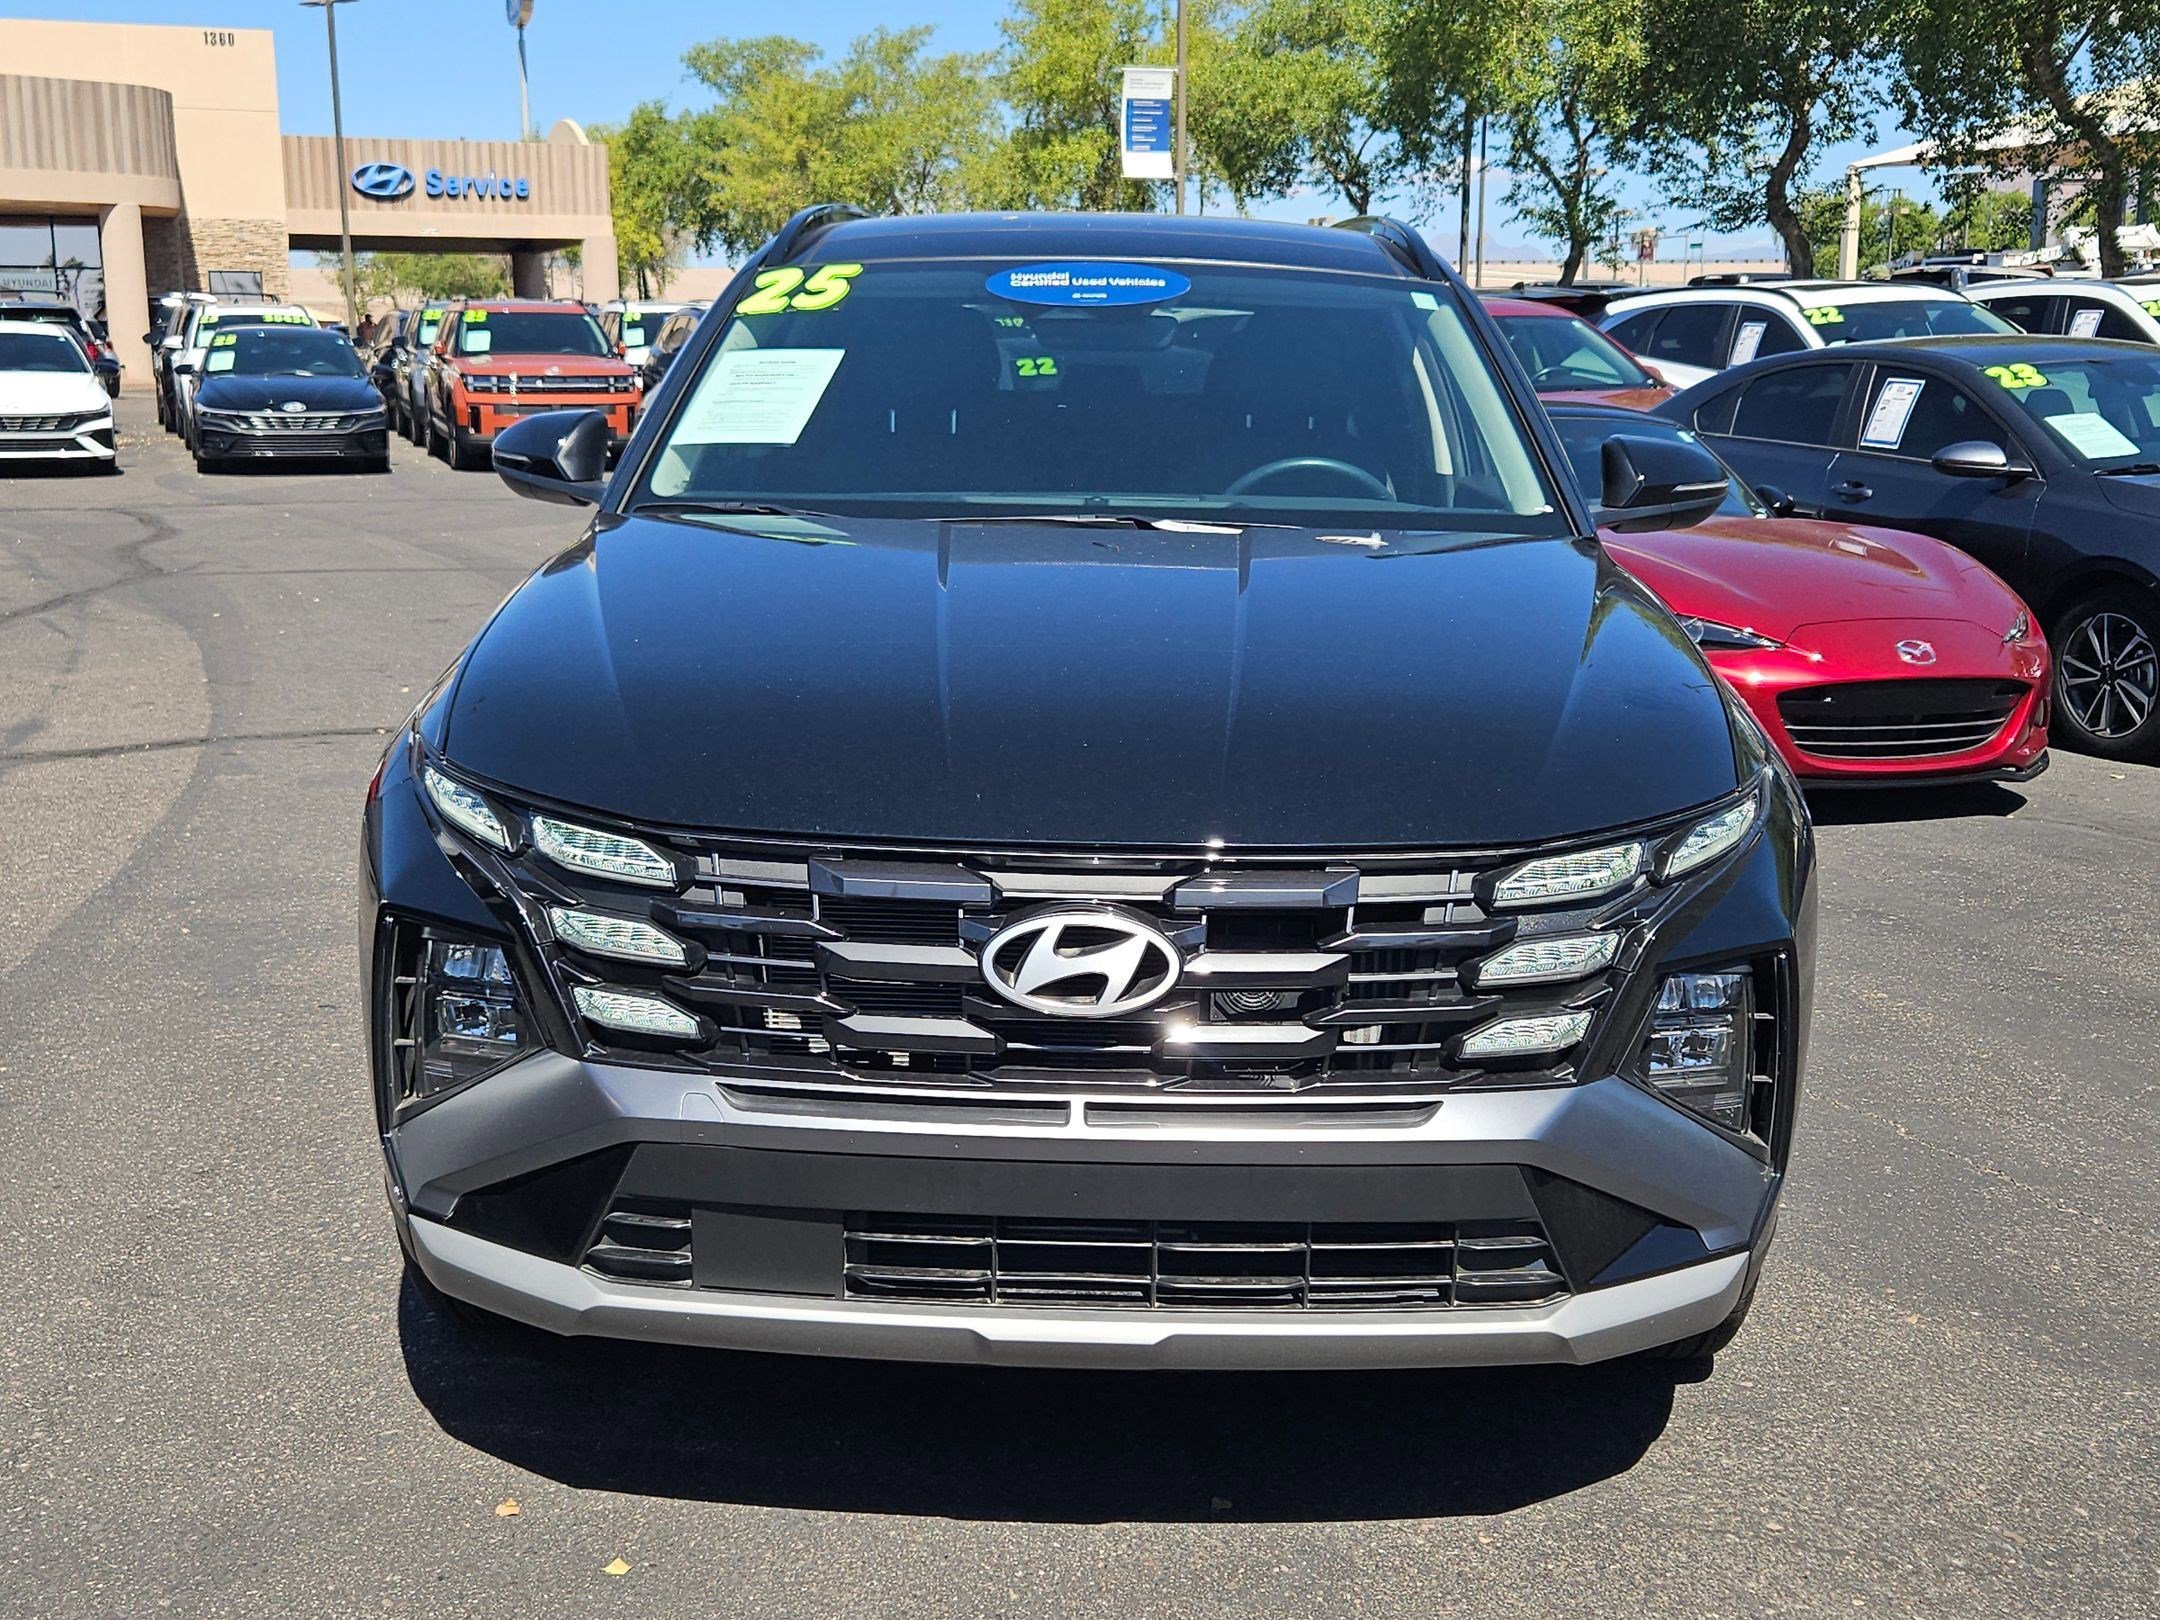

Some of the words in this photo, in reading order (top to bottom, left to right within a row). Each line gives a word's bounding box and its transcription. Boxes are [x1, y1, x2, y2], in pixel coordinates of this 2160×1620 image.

[425, 168, 530, 201] Service
[735, 263, 864, 316] 25
[1072, 277, 1107, 287] Used
[1109, 277, 1166, 287] Vehicles
[1803, 306, 1845, 325] 22
[2140, 298, 2160, 317] 2
[1015, 356, 1058, 377] 22
[1984, 362, 2048, 389] 23
